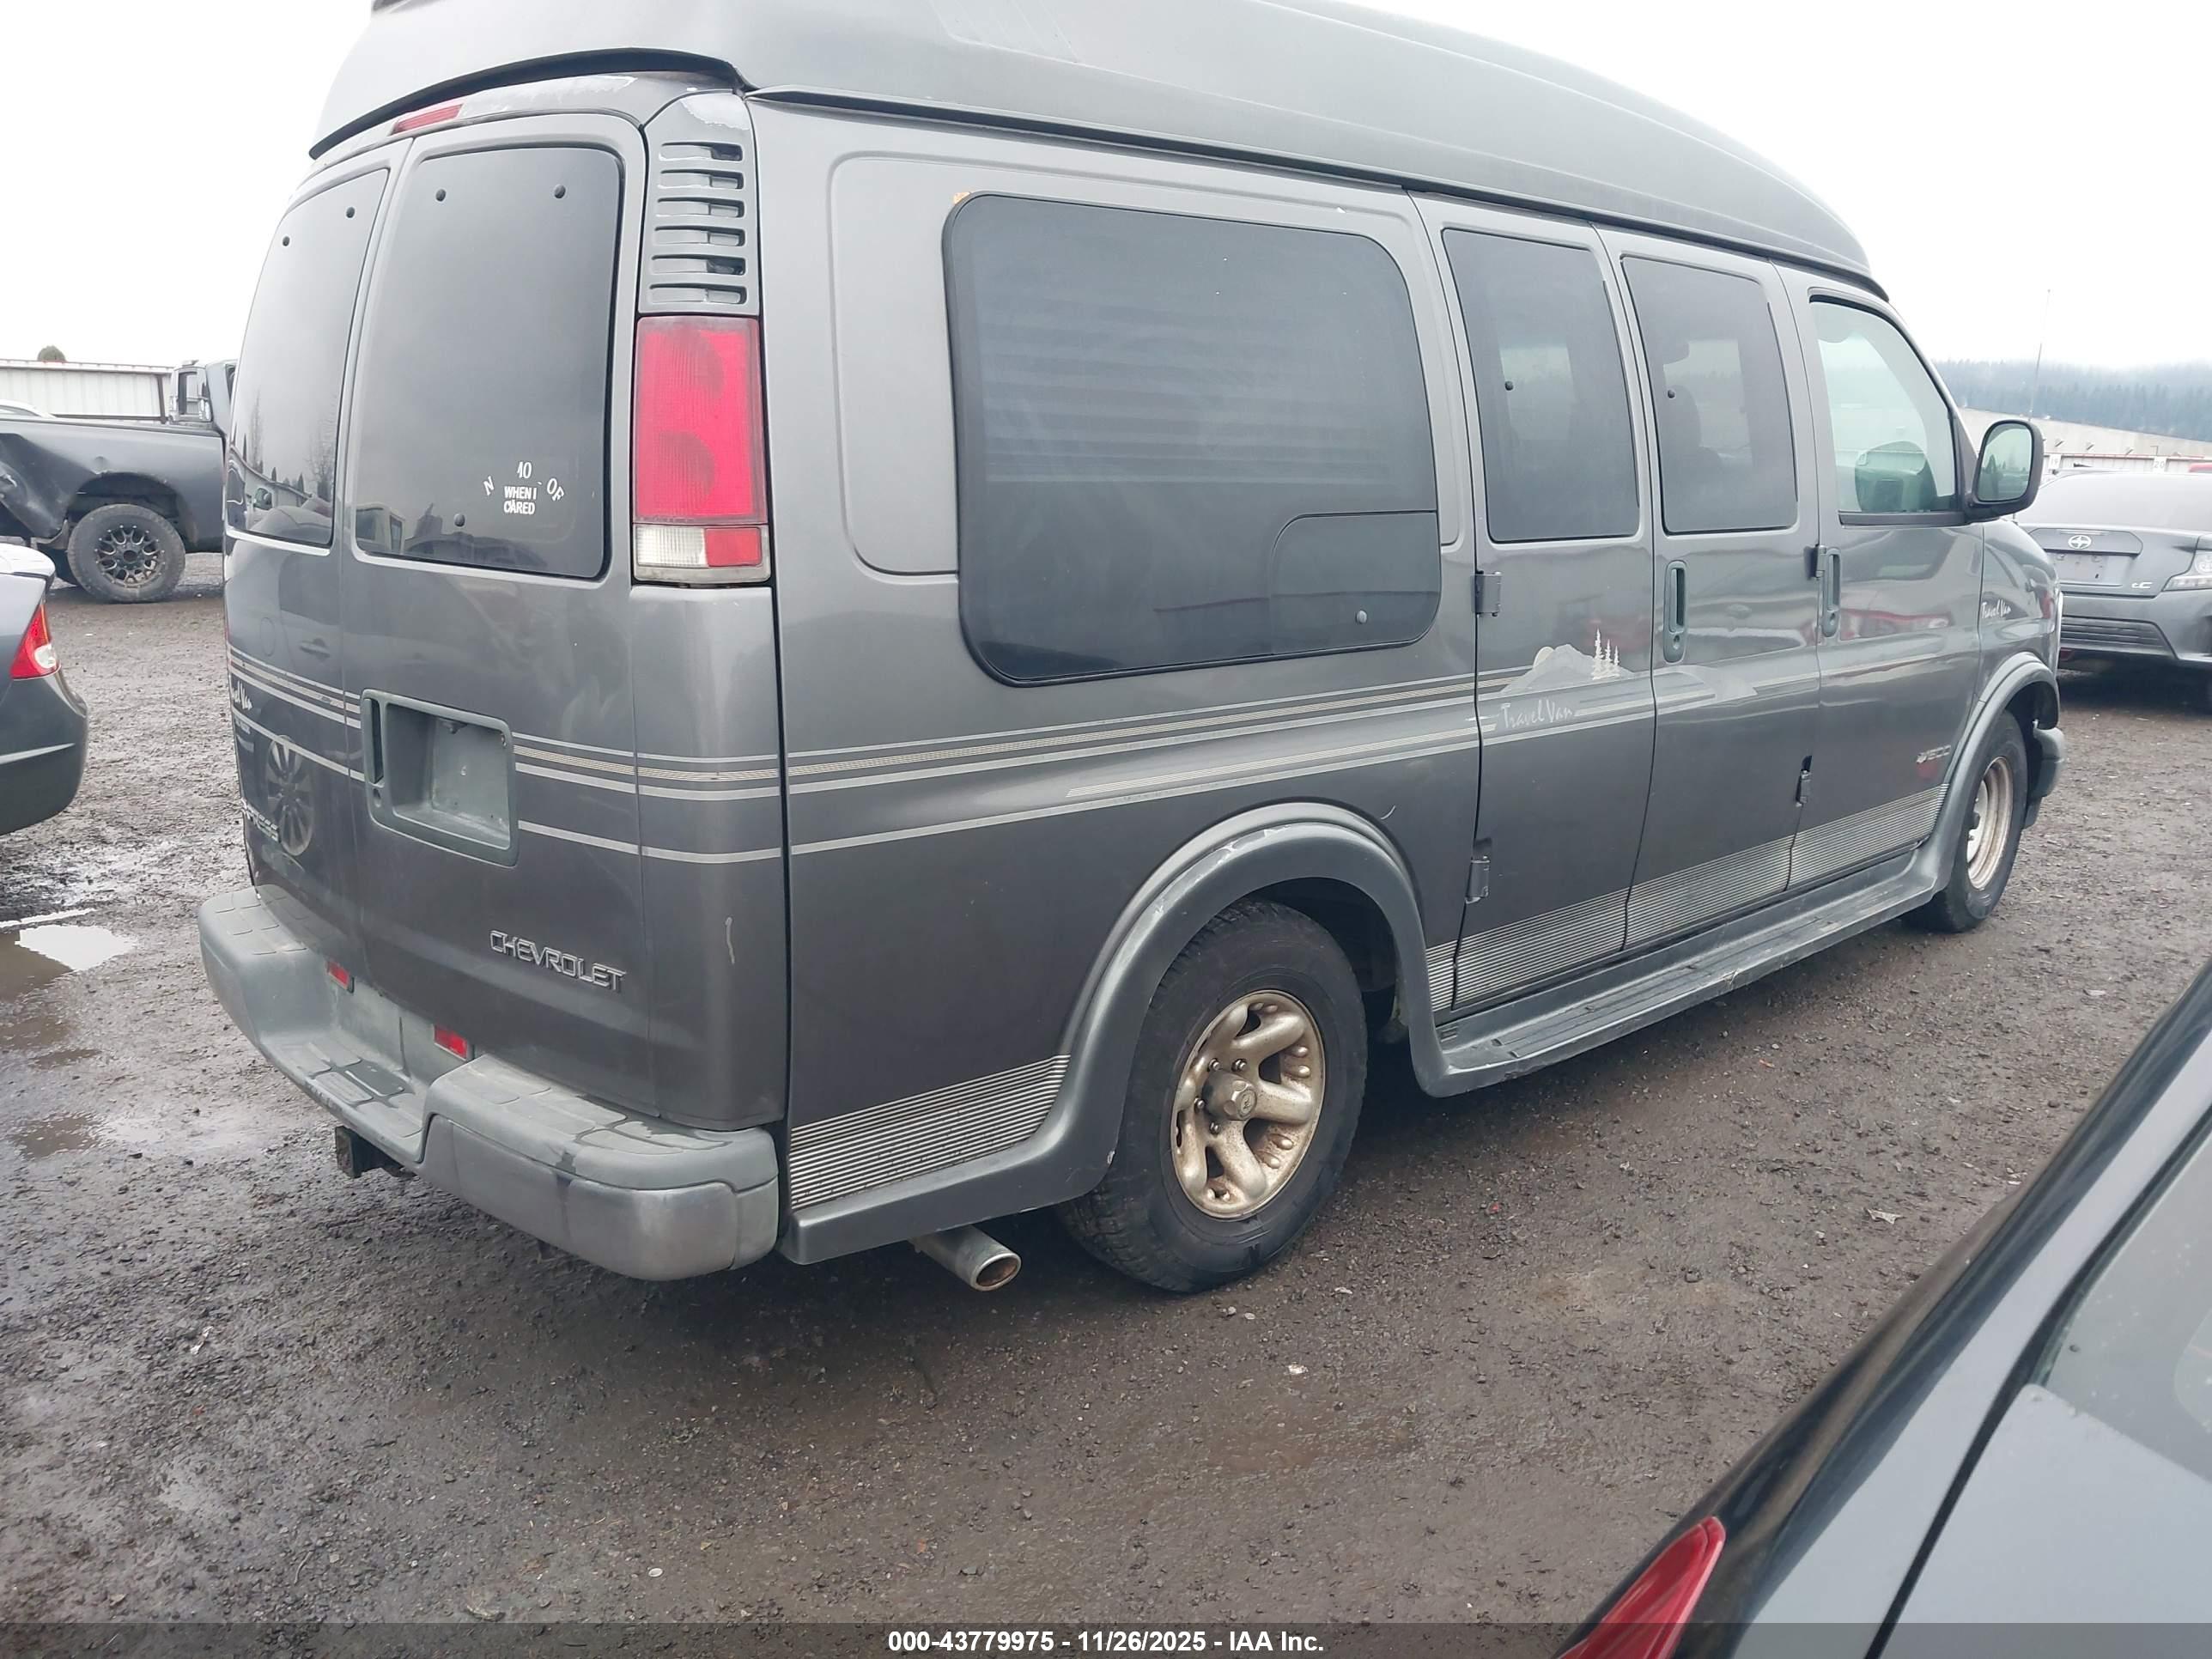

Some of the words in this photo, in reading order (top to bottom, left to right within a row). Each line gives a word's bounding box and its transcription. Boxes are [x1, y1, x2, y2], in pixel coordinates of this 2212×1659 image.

[517, 461, 532, 479] 10
[504, 485, 532, 500] WHEN
[503, 500, 536, 515] CARED
[1500, 699, 1545, 729] Travel
[1546, 698, 1575, 723] Van
[489, 930, 627, 991] CHEVROLET
